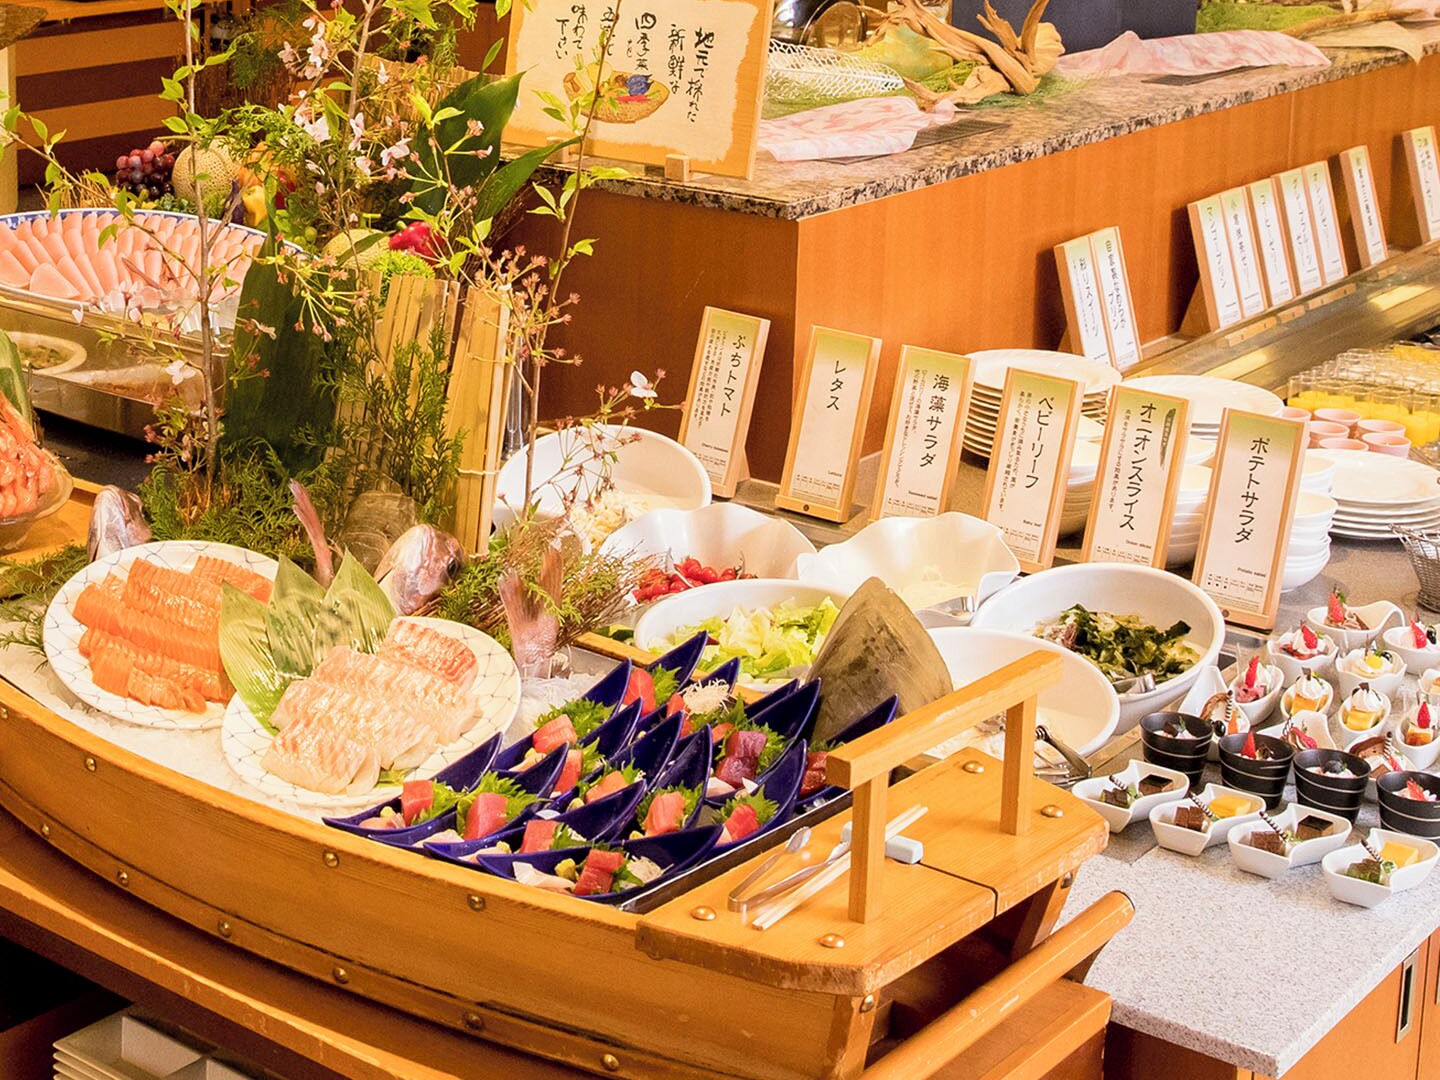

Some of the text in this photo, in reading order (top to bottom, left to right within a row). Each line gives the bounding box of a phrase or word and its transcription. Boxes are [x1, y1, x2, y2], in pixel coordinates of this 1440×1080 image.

[826, 360, 847, 411] レタス
[919, 373, 951, 468] 海藻サラダ
[1119, 402, 1157, 531] オニオンスライス
[1234, 437, 1271, 544] ポテトサラダ
